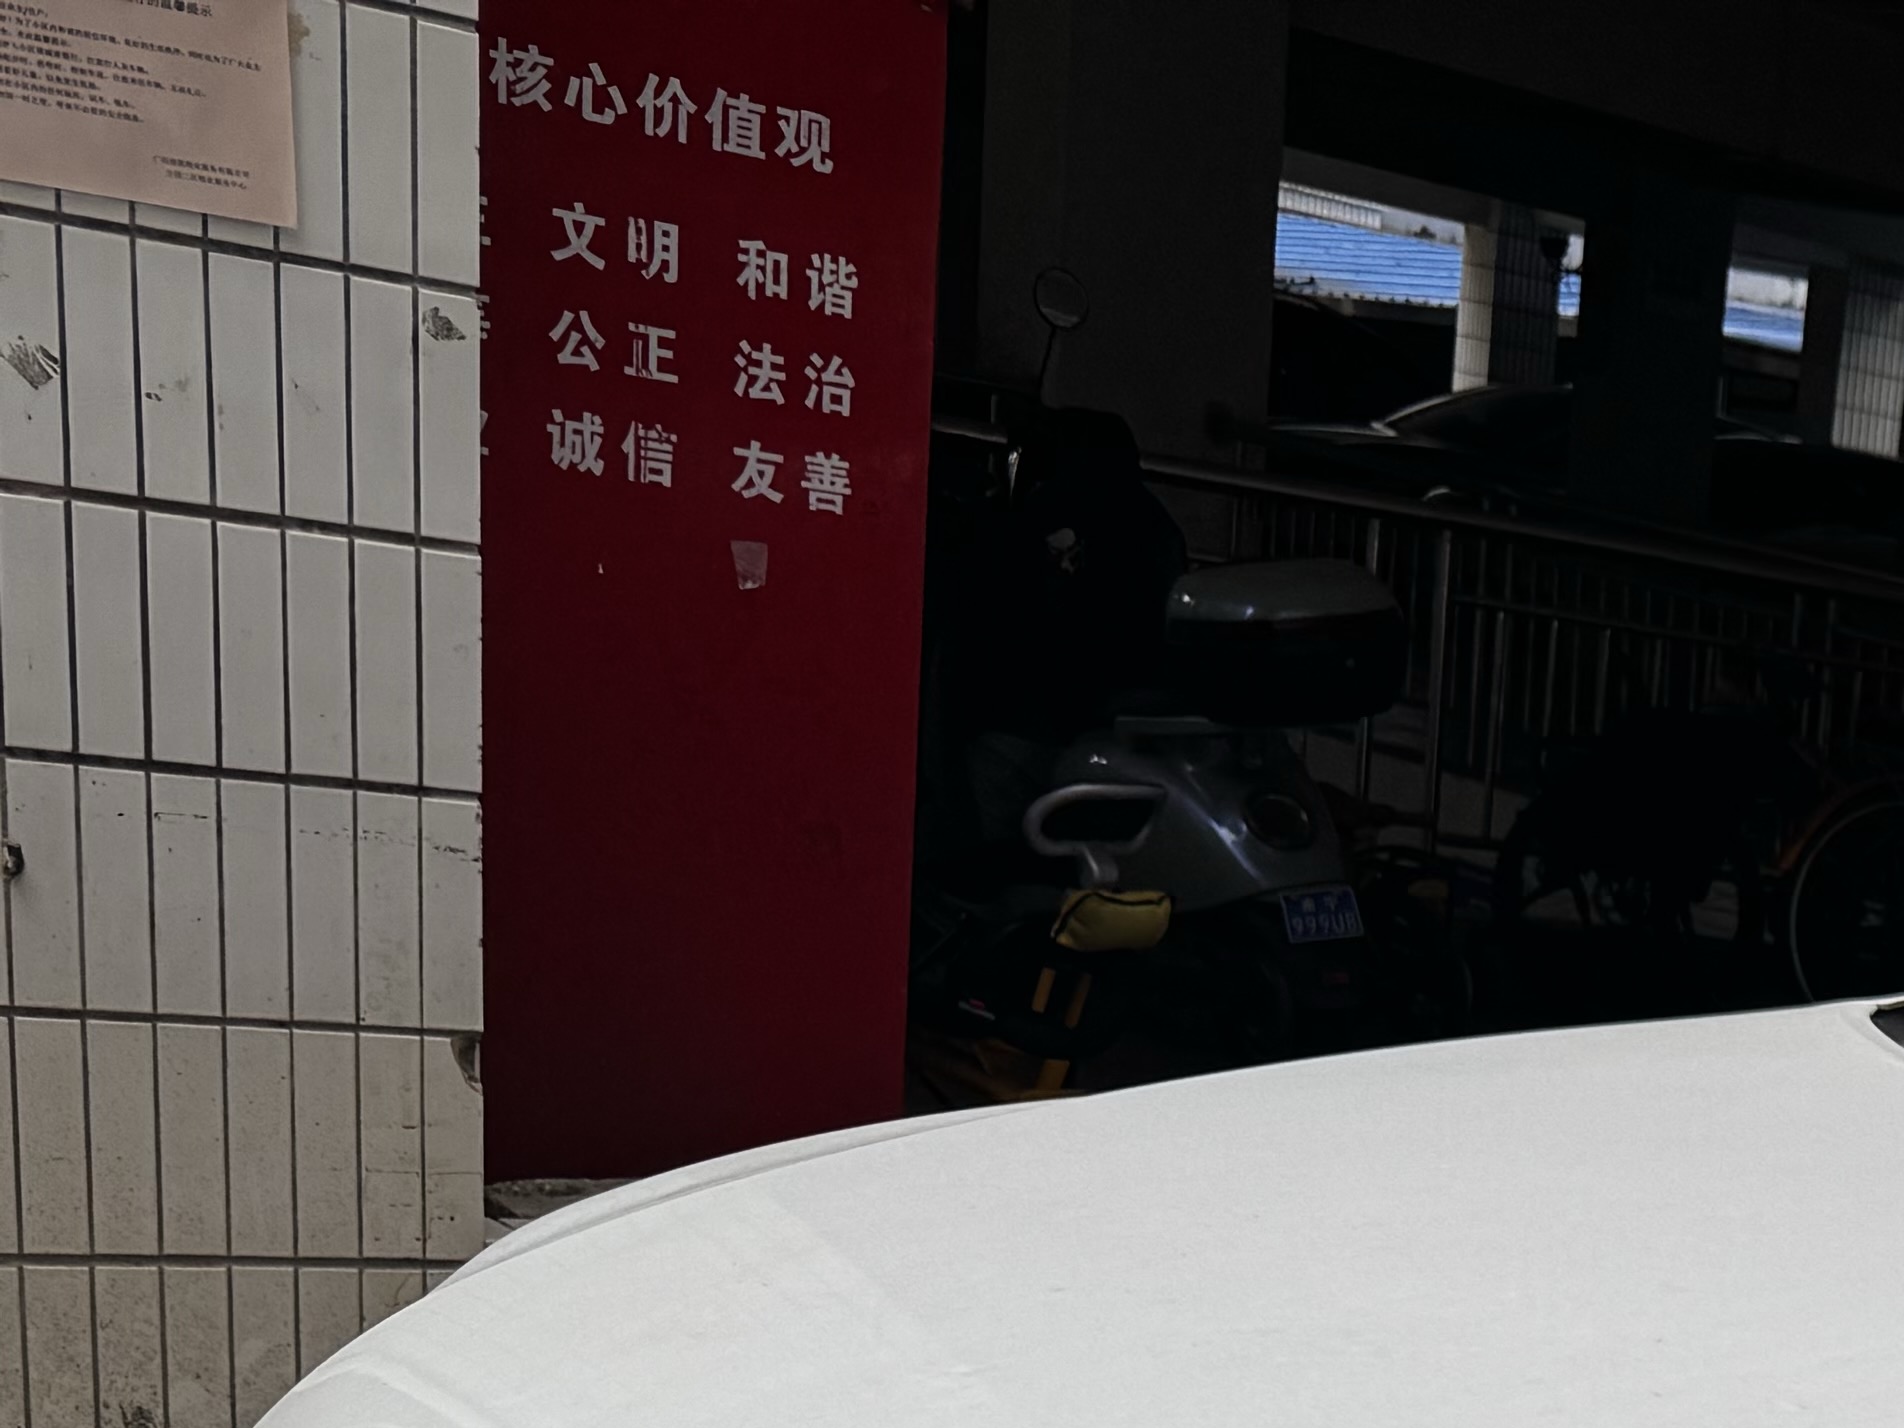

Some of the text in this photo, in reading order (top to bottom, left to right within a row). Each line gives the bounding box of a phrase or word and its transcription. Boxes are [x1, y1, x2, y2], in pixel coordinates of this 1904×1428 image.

[489, 37, 834, 174] 核心价值观
[550, 202, 680, 284] 文明
[736, 239, 859, 320] 和谐
[548, 310, 680, 384] 公正
[734, 339, 855, 417] 法治
[546, 408, 678, 488] 诚信
[731, 440, 852, 516] 友善
